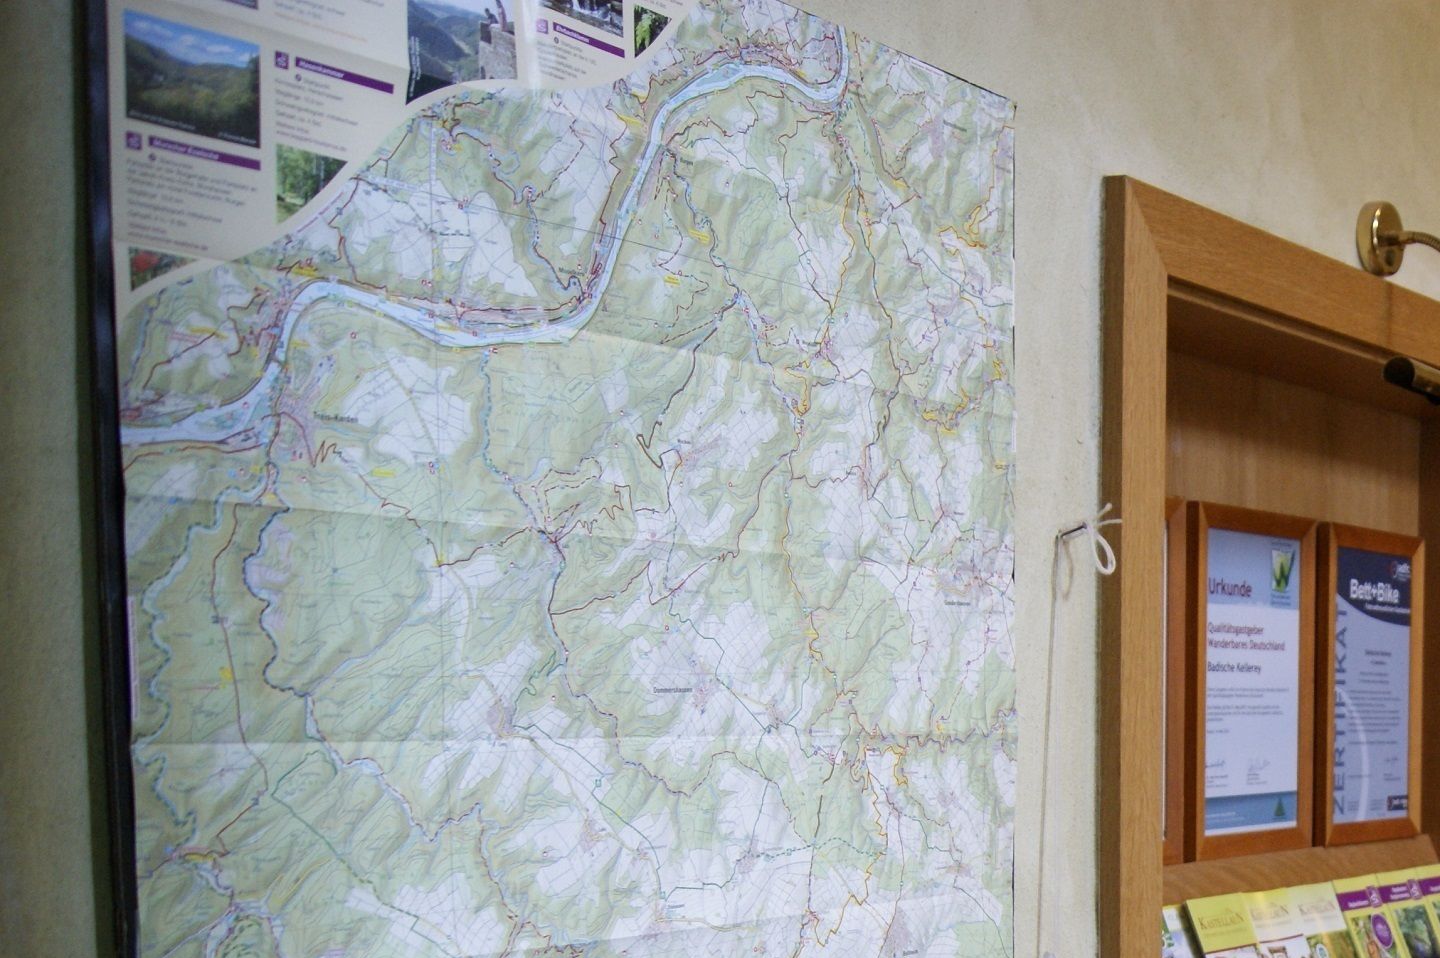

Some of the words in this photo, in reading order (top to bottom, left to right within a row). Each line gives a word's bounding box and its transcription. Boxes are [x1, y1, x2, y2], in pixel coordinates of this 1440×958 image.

[1208, 577, 1252, 598] Urkunde
[1208, 638, 1248, 650] Wanderbares
[1249, 639, 1286, 651] Deutschland
[1207, 660, 1235, 673] Badische
